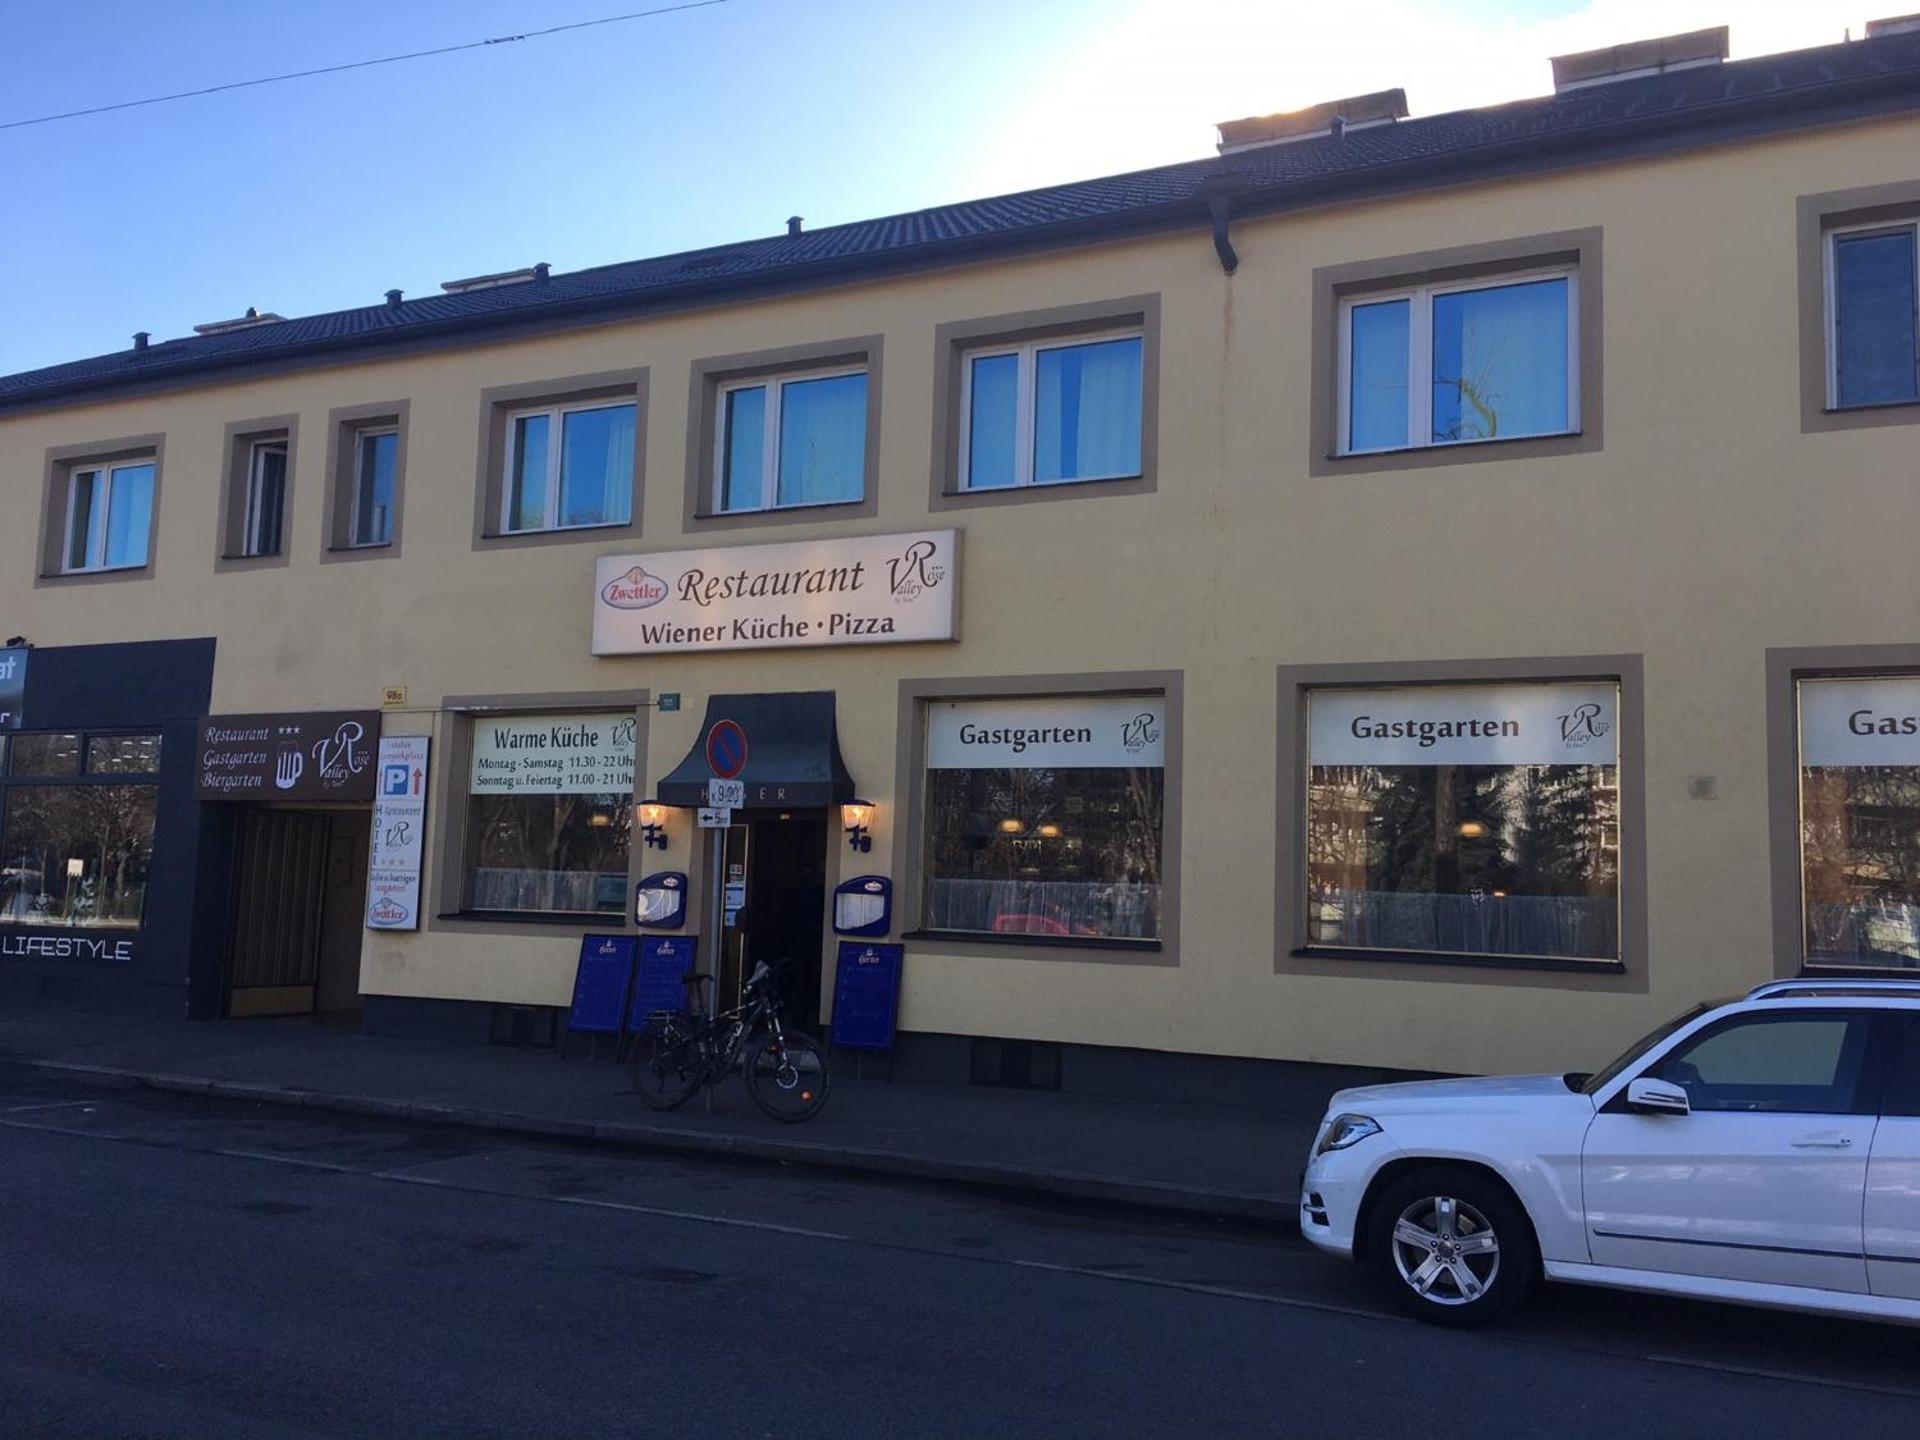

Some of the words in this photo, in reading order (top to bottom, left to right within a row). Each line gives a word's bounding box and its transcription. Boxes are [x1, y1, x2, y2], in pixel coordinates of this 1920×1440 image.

[610, 583, 662, 601] Zwettler
[677, 561, 864, 607] Restaurant
[641, 621, 726, 645] Wiener
[732, 613, 809, 641] Küche
[829, 612, 896, 636] Pizza
[1351, 716, 1519, 748] Gastgarten
[1848, 709, 1920, 735] Gas
[205, 727, 269, 744] Restaurant
[494, 728, 547, 749] Warme
[551, 724, 599, 748] Küche
[959, 724, 1091, 753] Gastgarten
[203, 751, 267, 770] Gastgarten
[478, 758, 517, 772] Montag
[523, 757, 564, 771] Samstag
[568, 756, 596, 768] 11.30
[603, 755, 615, 767] 22
[202, 773, 262, 792] Biergarten
[477, 775, 514, 790] Sonntag
[515, 777, 524, 786] u.
[526, 774, 562, 789] Feiertag
[568, 773, 595, 785] 11.00
[602, 773, 614, 785] 21
[701, 786, 786, 801] HER
[3, 936, 132, 960] LIFESTYLE
